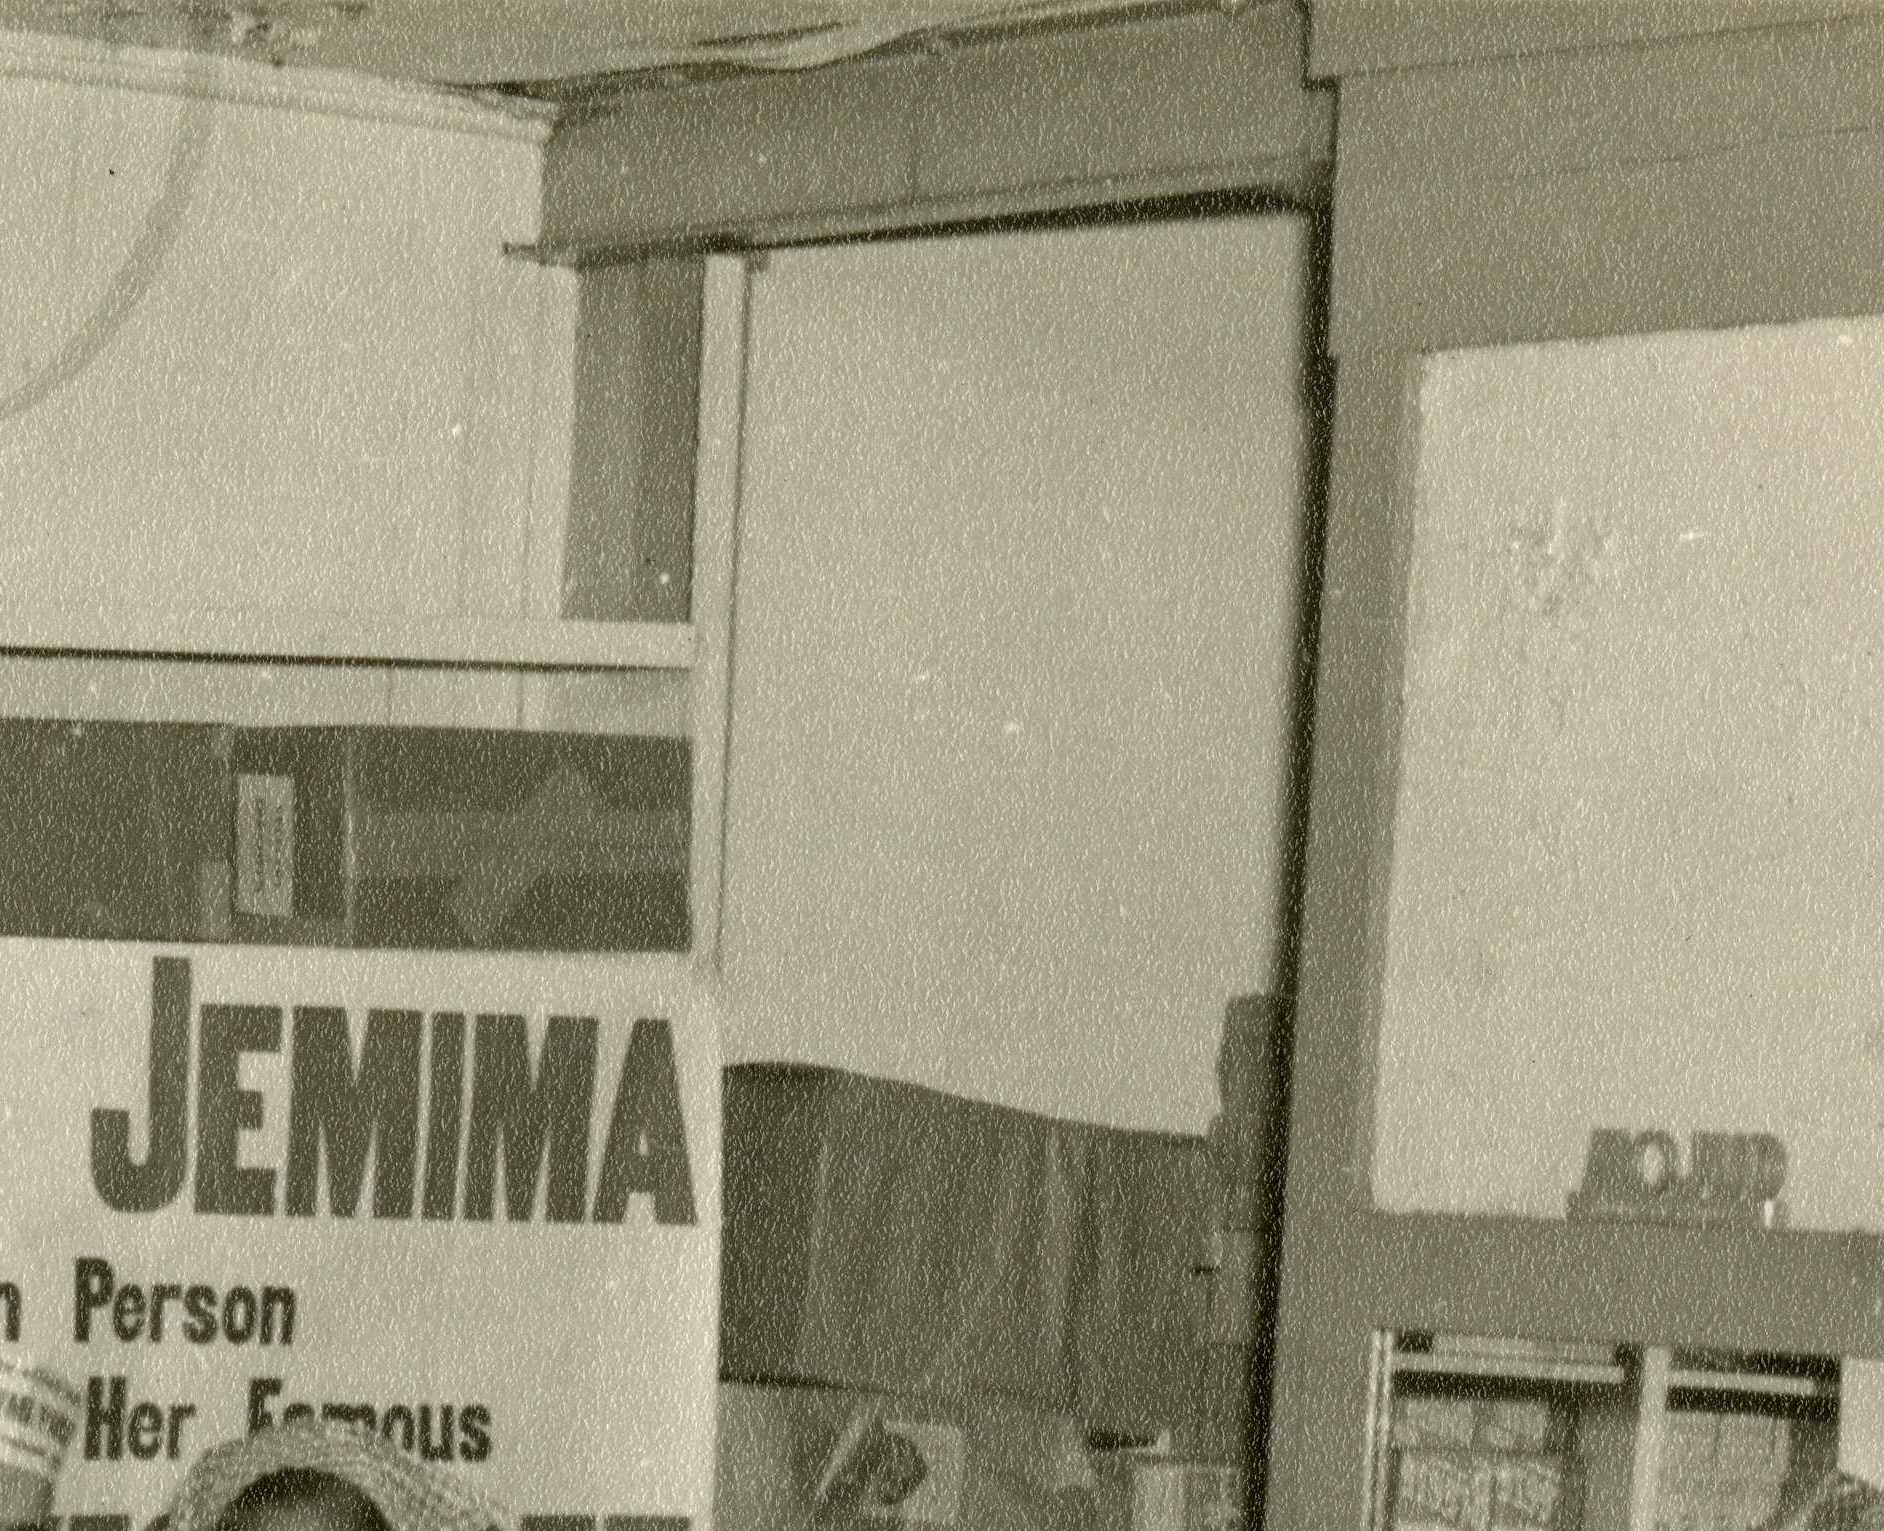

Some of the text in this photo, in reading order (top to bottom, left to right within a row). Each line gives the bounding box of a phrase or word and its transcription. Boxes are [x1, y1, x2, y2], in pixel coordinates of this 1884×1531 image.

[90, 957, 699, 1226] JEMIMA
[74, 1259, 296, 1344] Person
[83, 1375, 195, 1461] Her
